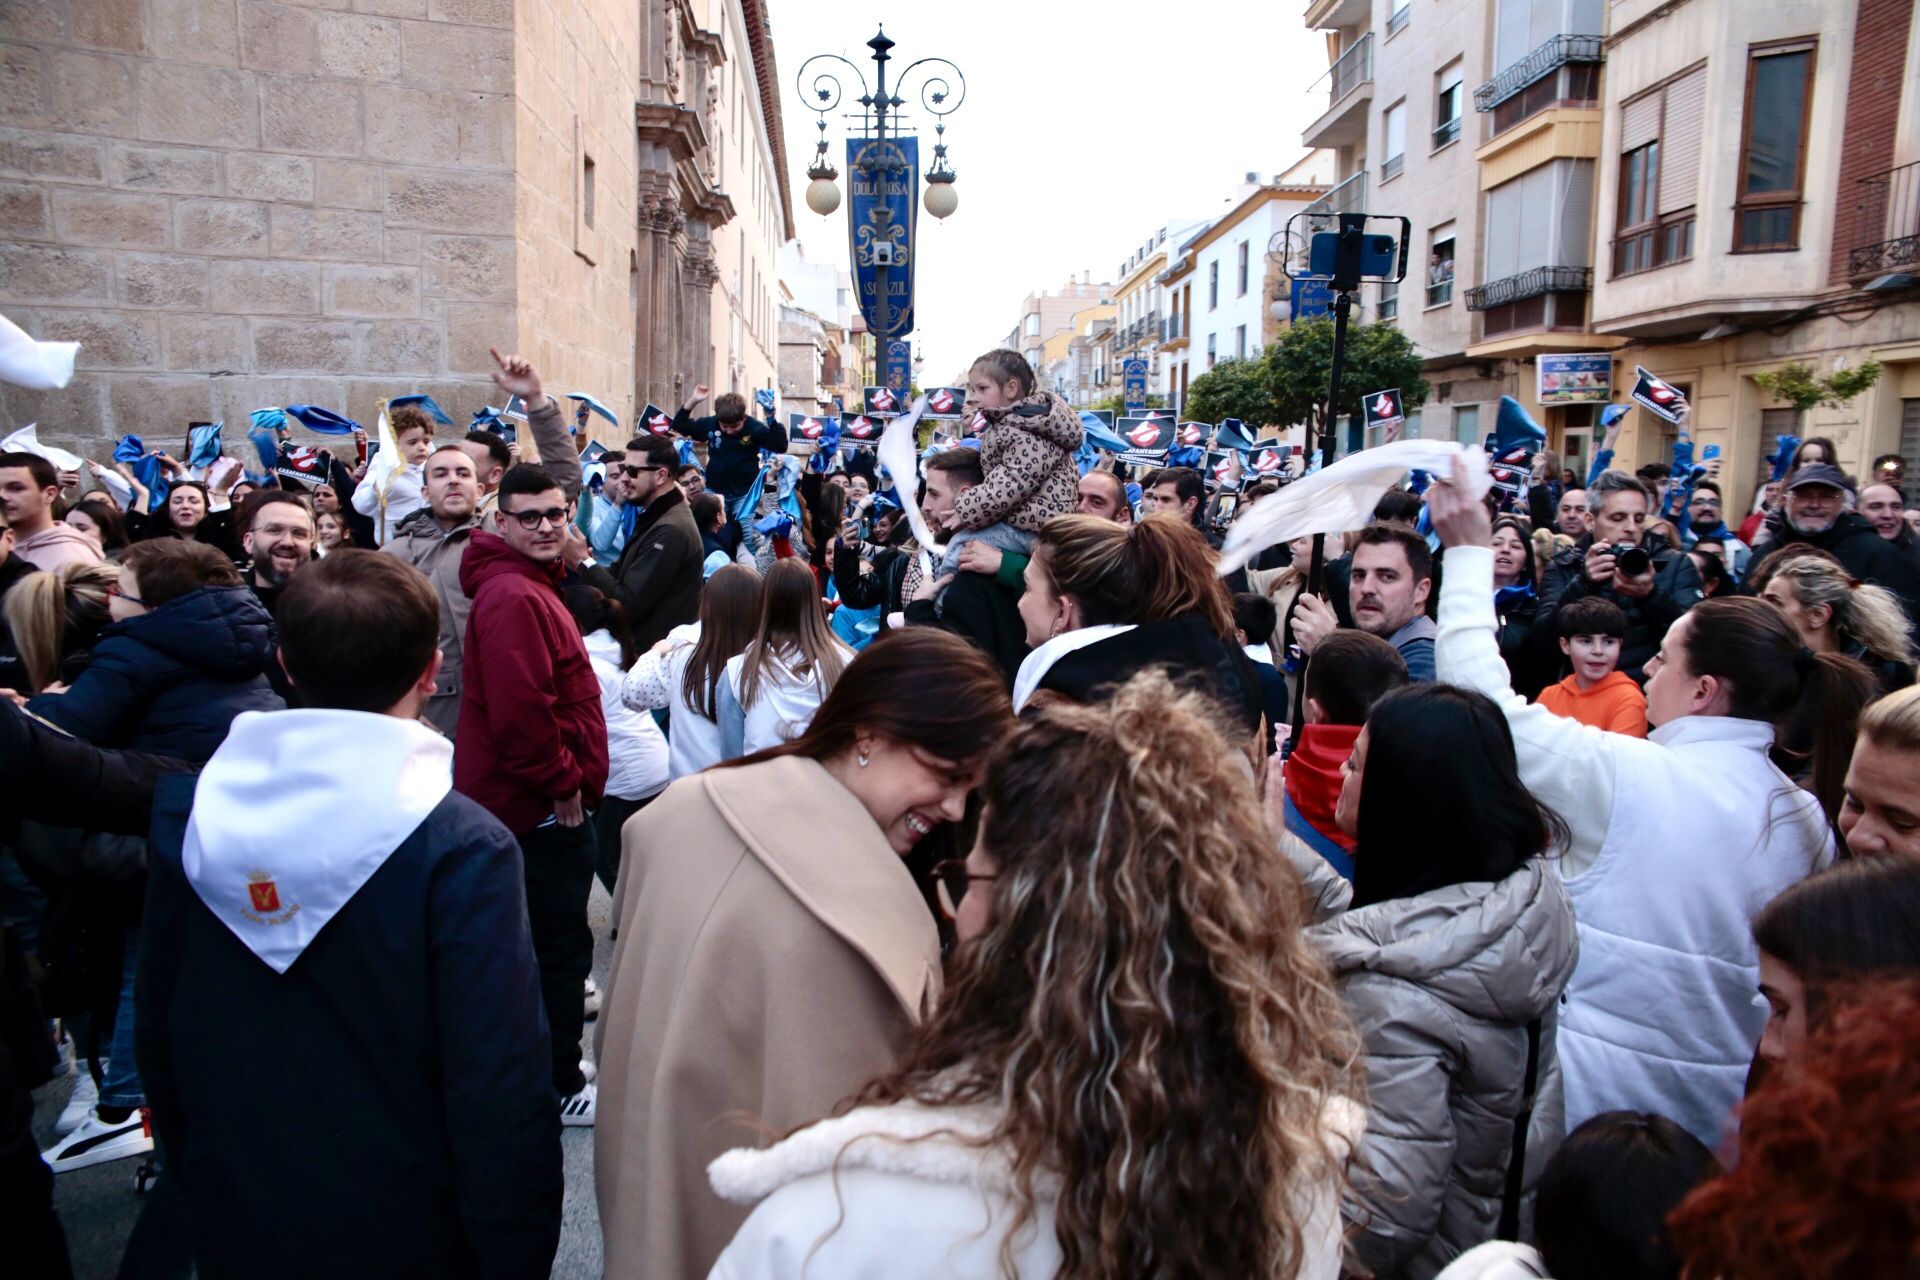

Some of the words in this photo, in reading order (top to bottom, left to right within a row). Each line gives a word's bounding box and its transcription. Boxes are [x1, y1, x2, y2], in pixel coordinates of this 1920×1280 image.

[853, 181, 908, 196] DOLOSA
[887, 281, 908, 296] ZUL
[278, 467, 326, 483] CAZAFANTASMAS
